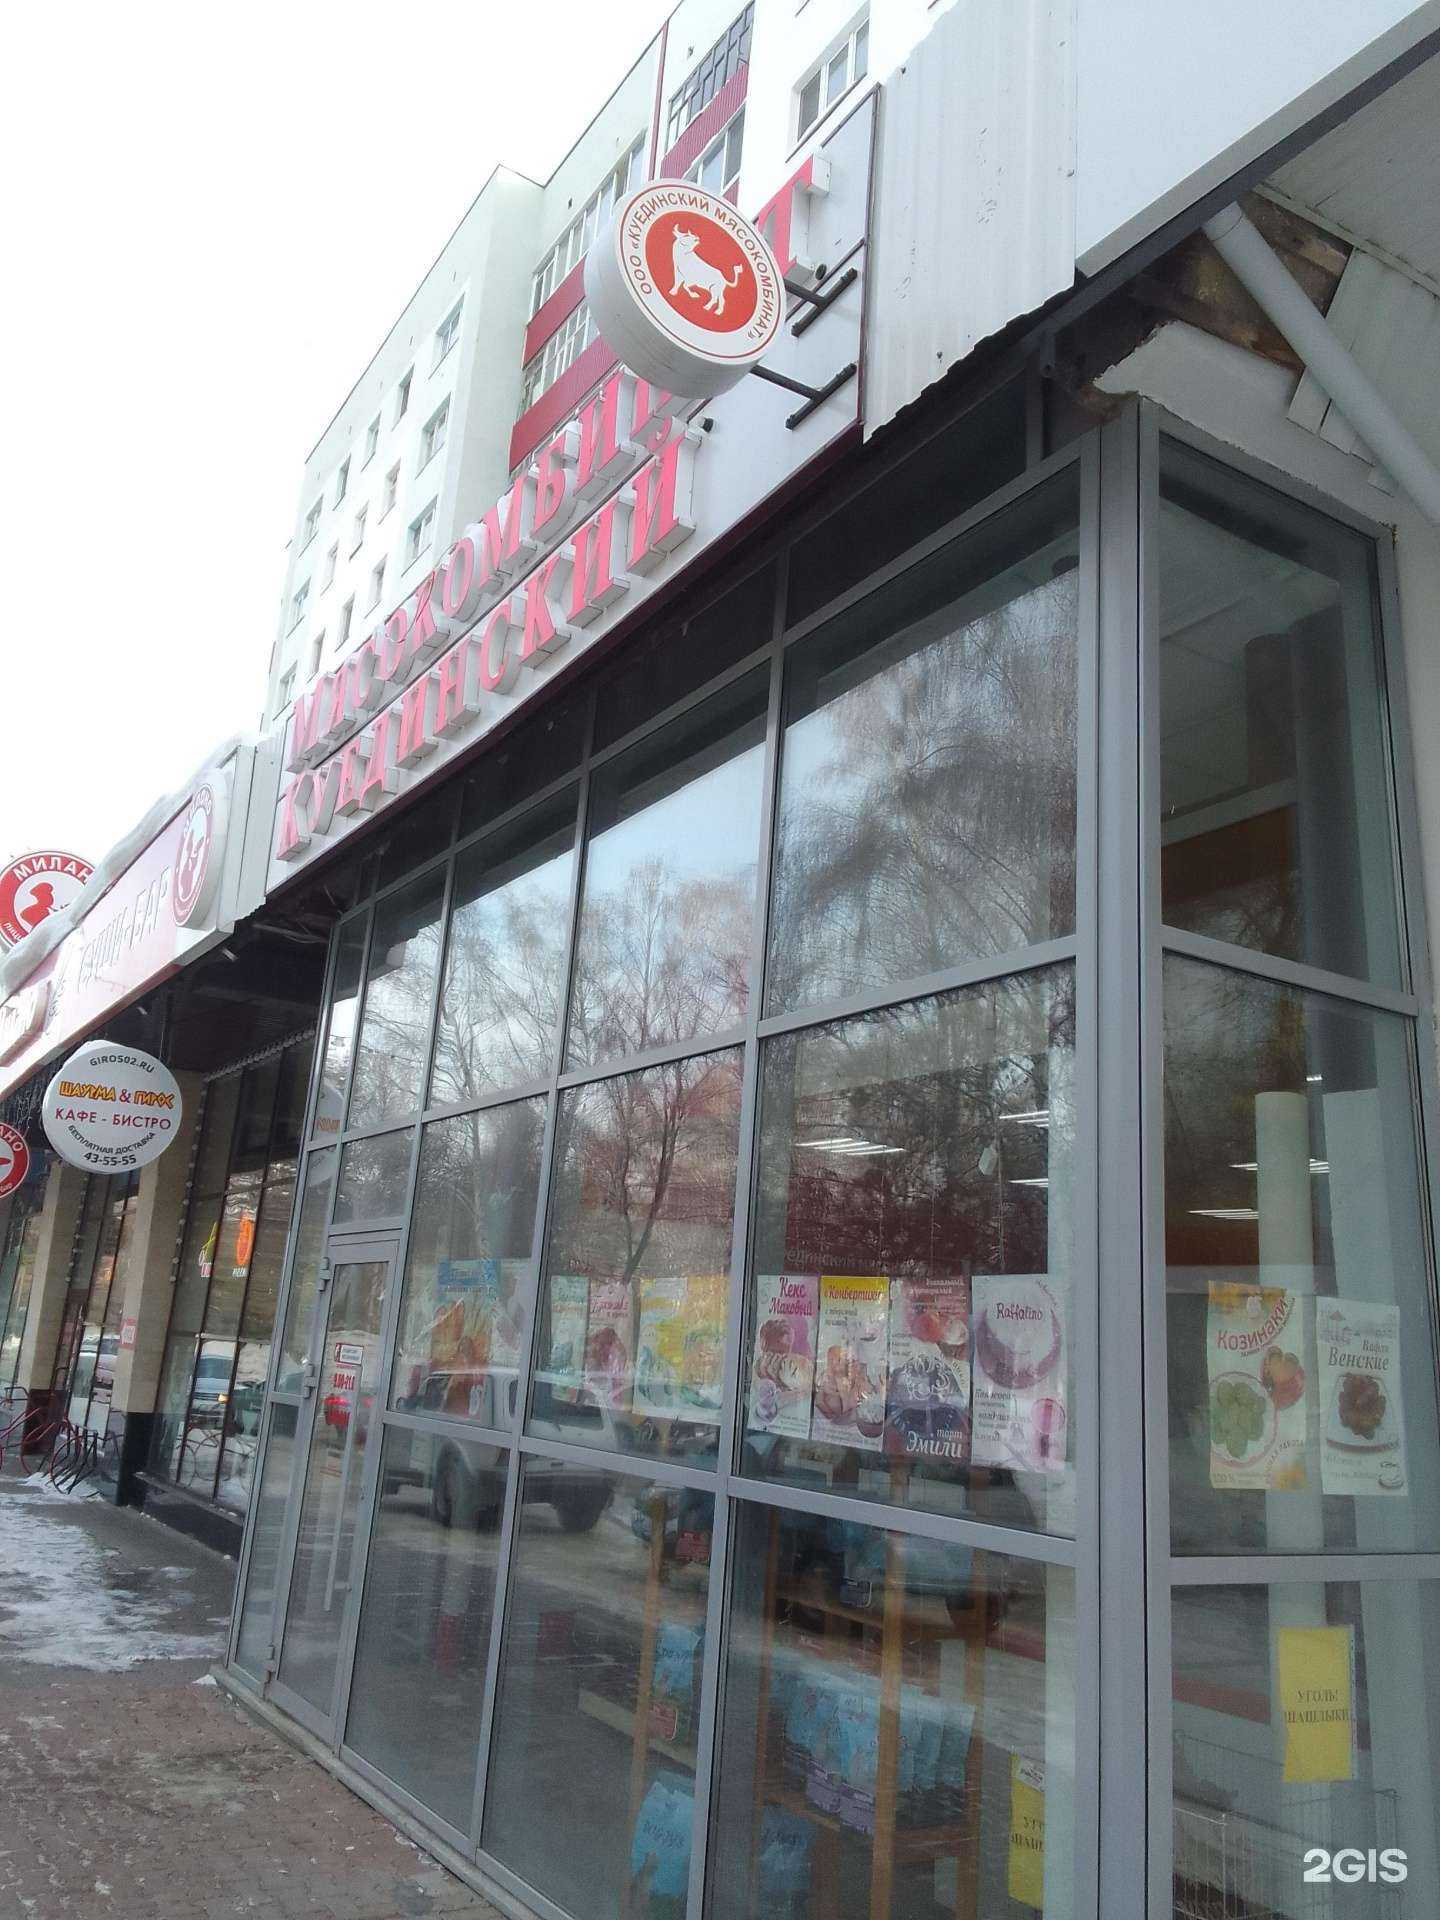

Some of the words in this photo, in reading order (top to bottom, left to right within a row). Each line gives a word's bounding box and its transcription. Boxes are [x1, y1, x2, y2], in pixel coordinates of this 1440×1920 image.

[627, 192, 710, 251] «КУЕДИНСКИЙ
[627, 255, 653, 296] ООО
[713, 206, 775, 341] МЯСОКОМБИНАТ»
[287, 153, 828, 772] МЯСОКОМБИНТ
[276, 415, 698, 860] КУЕДИНСКИЙ
[12, 856, 96, 885] МИЛАН
[59, 1081, 116, 1102] ШАУРМА
[119, 1088, 131, 1104] &
[55, 1107, 97, 1124] КАФЕ
[112, 1113, 171, 1130] БИСТРО
[68, 1125, 113, 1154] БЕСПЛАТНАЯ
[115, 1132, 155, 1155] ДОСТАВКА
[84, 1151, 137, 1167] 43-55-55
[779, 1276, 807, 1298] Кекс
[1216, 1296, 1289, 1351] Козинаки
[1328, 1345, 1390, 1371] Венские
[905, 1430, 962, 1458] Эмили
